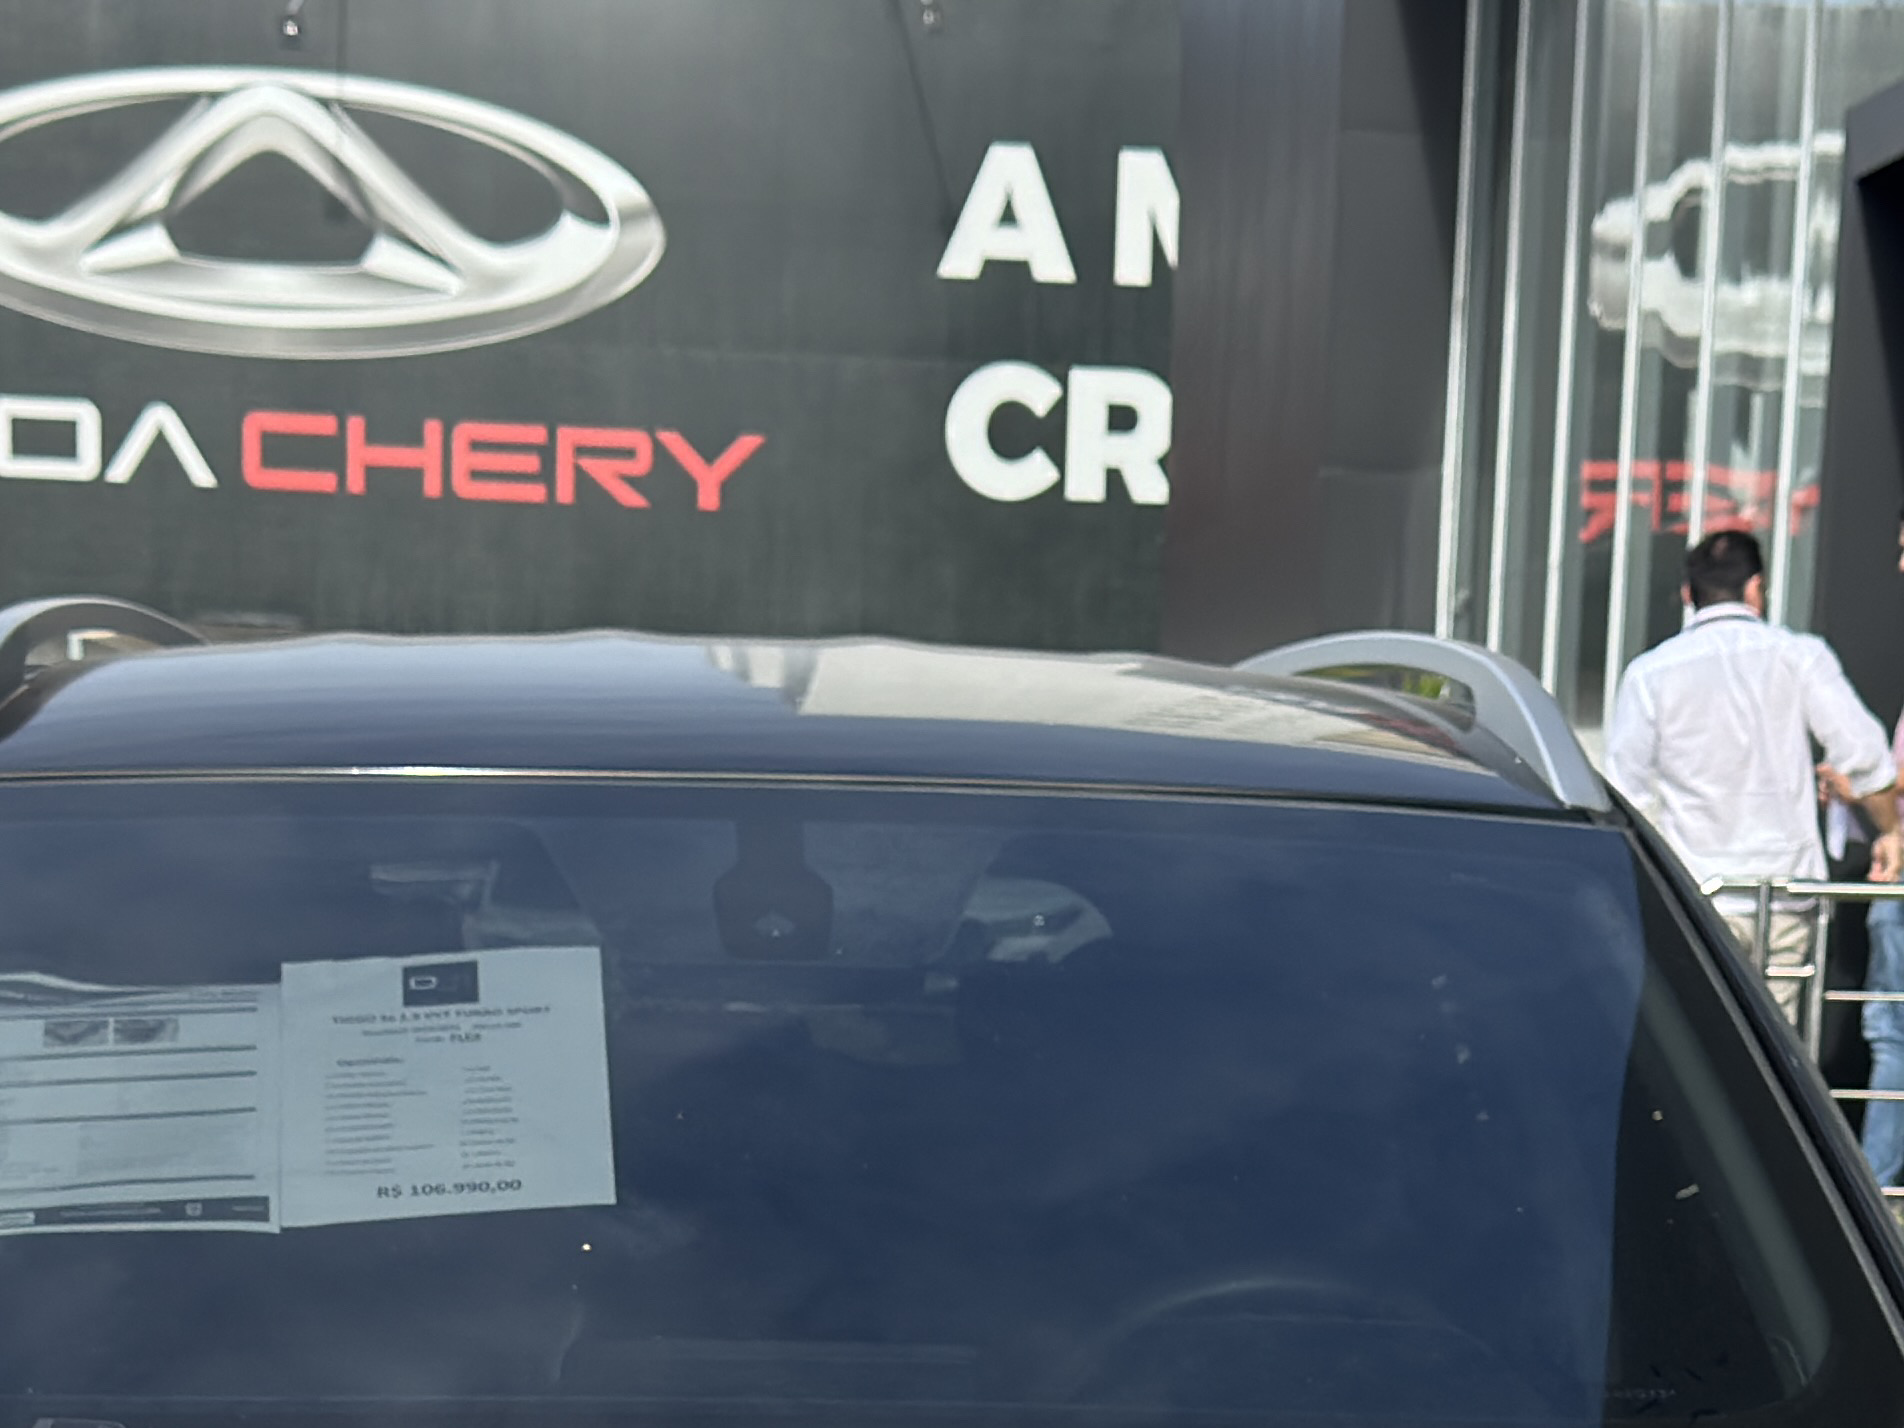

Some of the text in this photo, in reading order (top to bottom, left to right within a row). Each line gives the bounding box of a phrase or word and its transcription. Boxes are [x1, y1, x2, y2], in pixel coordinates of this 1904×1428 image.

[937, 142, 1077, 284] A
[240, 409, 767, 512] CHERY
[945, 360, 1174, 506] CR
[377, 1179, 523, 1199] R$ 106.990,00
